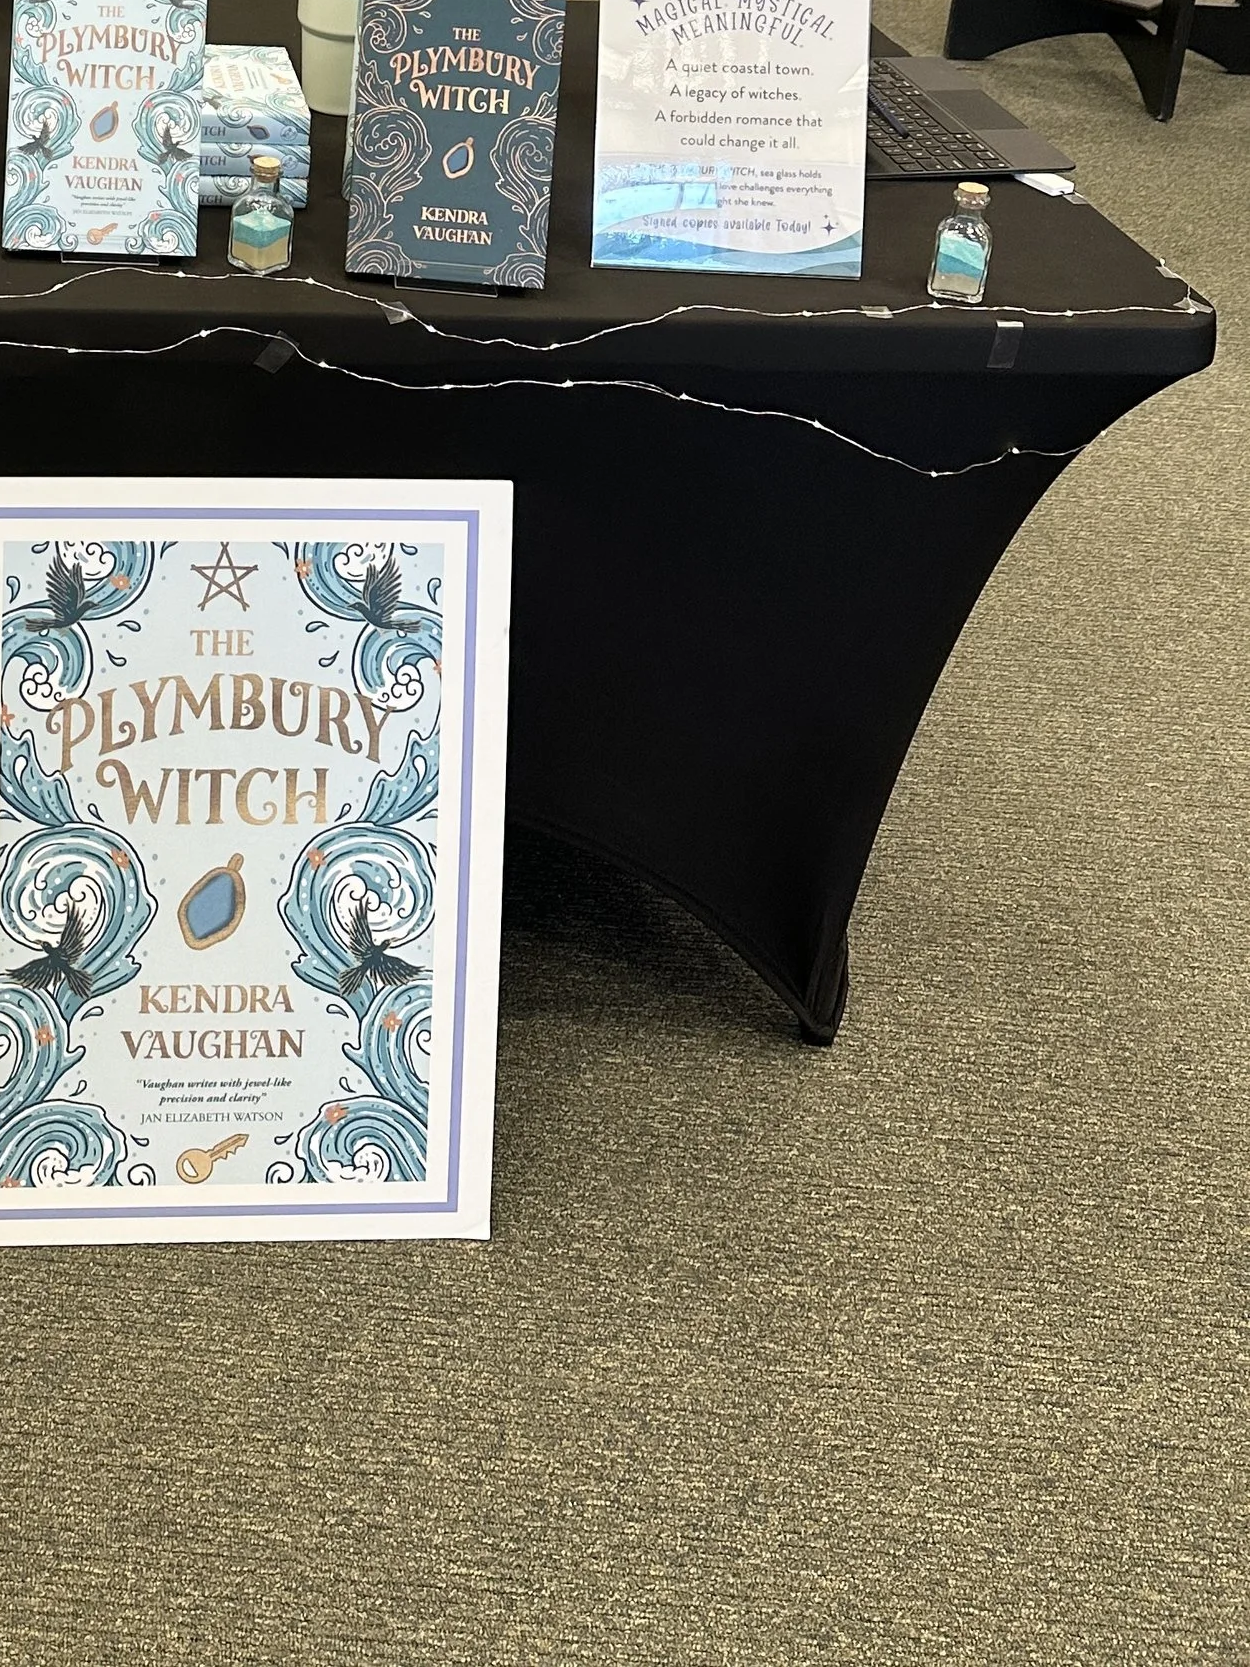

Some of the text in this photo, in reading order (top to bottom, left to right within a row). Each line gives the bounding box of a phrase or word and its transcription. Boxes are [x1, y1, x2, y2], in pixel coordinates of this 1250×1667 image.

[98, 5, 125, 18] THE
[452, 27, 481, 42] THE
[671, 12, 805, 48] MEANINGFUL.
[37, 24, 184, 65] PLYMBURY
[57, 57, 156, 91] WITCH
[389, 45, 541, 91] PLYMBURY
[665, 59, 815, 77] A quiet coastal town.
[409, 78, 511, 115] WITCH
[670, 84, 802, 102] A legacy of witches.
[655, 109, 823, 128] A forbidden romance that
[680, 134, 800, 152] could change it all.
[72, 155, 139, 172] KENDRA
[65, 175, 143, 192] VAUGHAN
[760, 168, 822, 181] sea glass holds
[739, 184, 784, 195] challenges
[786, 186, 833, 197] everything
[734, 198, 749, 206] she
[420, 206, 489, 226] KENDRA
[643, 215, 812, 233] Signed copies available Today!
[413, 225, 493, 246] VAUGHAN
[190, 629, 254, 657] THE
[45, 672, 396, 774] PLYMBURY
[96, 758, 329, 825] WITCH
[138, 984, 294, 1015] KENDRA
[120, 1029, 306, 1060] VAUGHAN
[187, 1079, 218, 1089] writes
[220, 1078, 243, 1088] with
[242, 1077, 293, 1091] jewel-like
[158, 1093, 204, 1107] precision
[206, 1093, 226, 1103] and
[140, 1111, 284, 1125] JAN ELIZABETH WATSON
